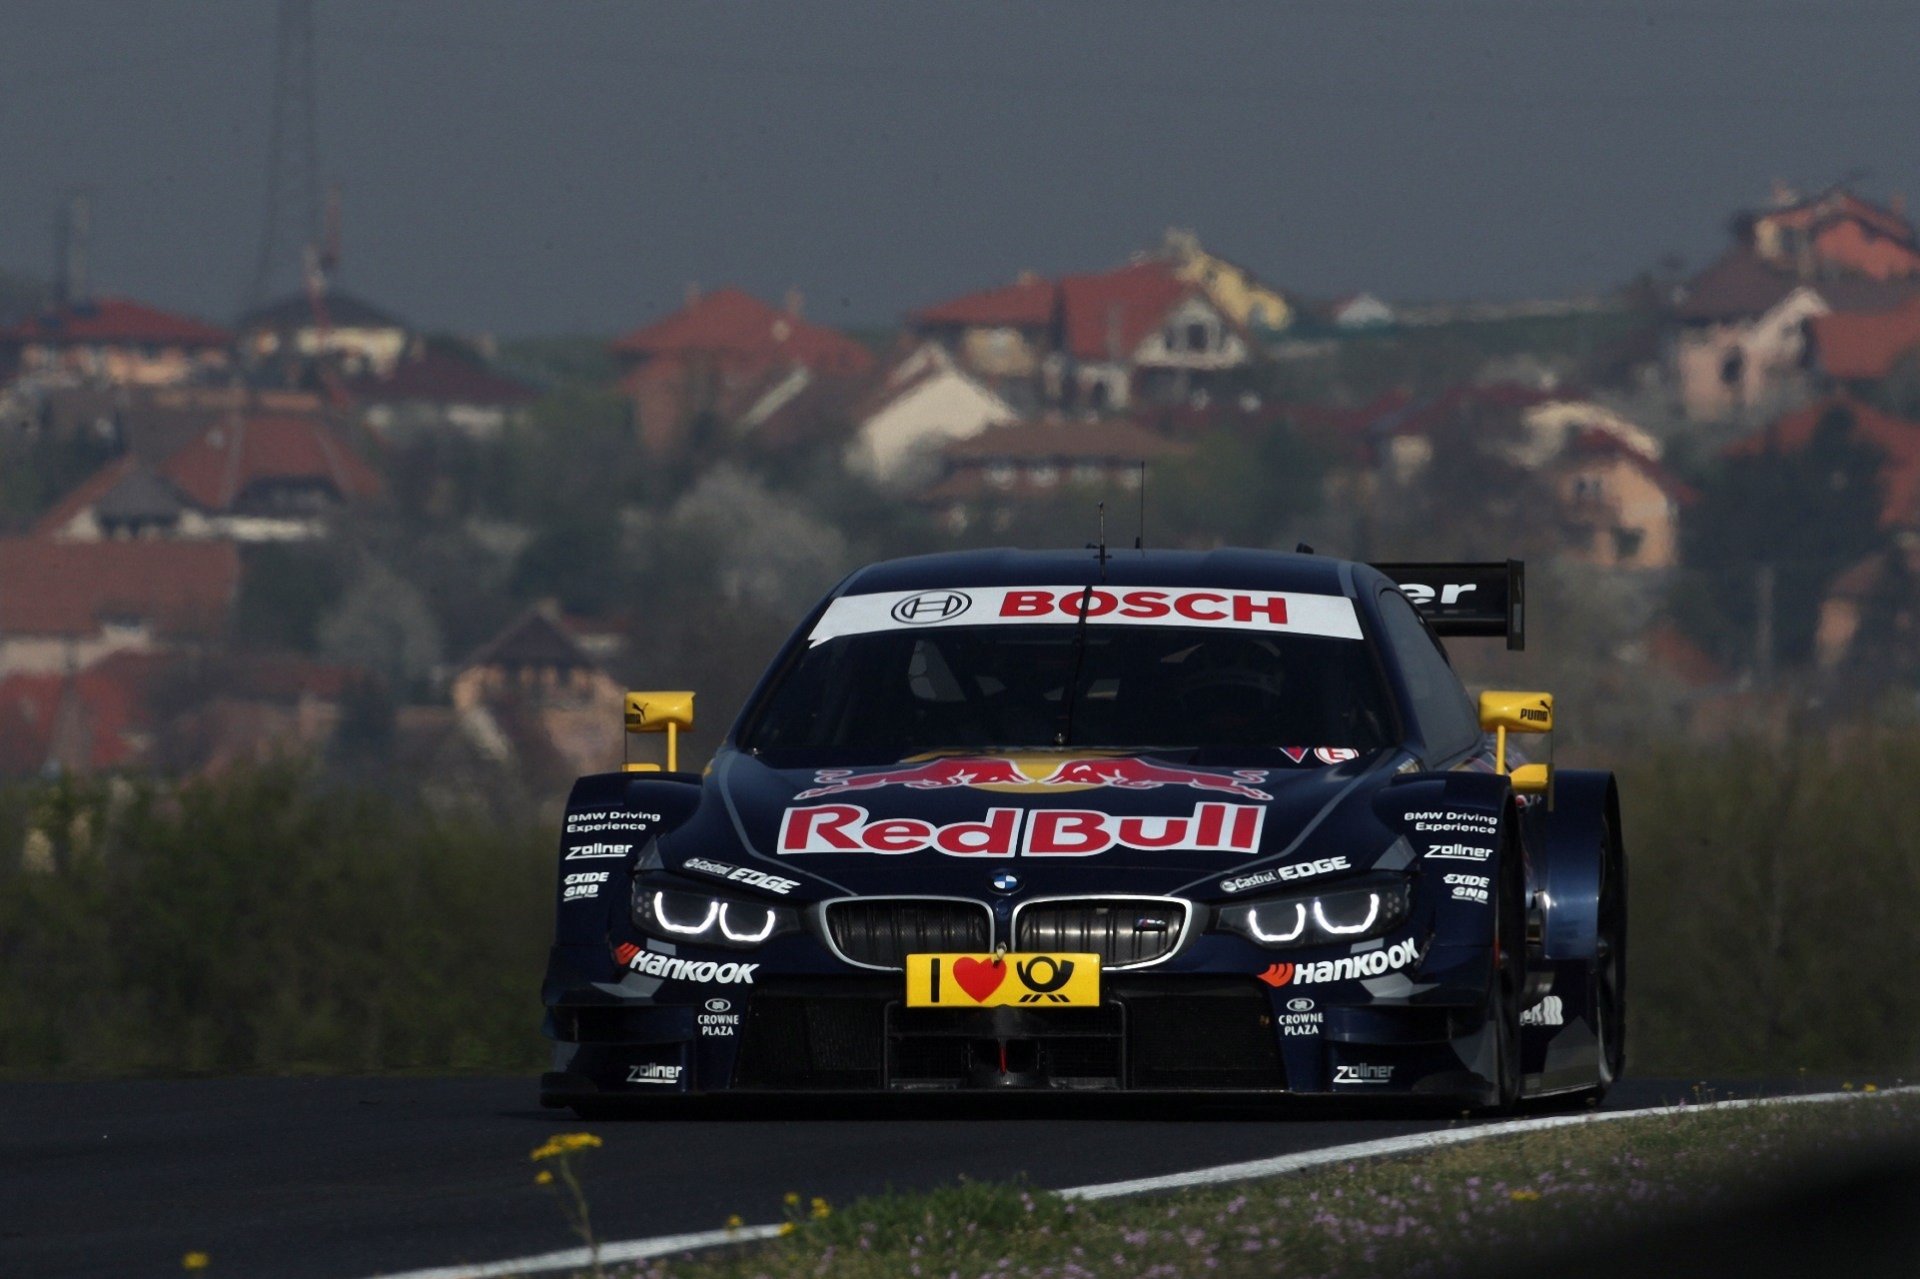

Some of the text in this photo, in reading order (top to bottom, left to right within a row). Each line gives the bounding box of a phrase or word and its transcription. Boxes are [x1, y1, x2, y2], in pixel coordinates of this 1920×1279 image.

[999, 591, 1288, 625] BOSCH
[1520, 708, 1548, 722] PUMA
[568, 811, 661, 823] BMW Driving
[1404, 812, 1498, 825] BMW Driving
[566, 822, 647, 833] Experience
[777, 802, 1267, 857] Red Bull
[1415, 822, 1497, 834] Experience
[564, 872, 610, 885] EXIDE
[1234, 856, 1351, 889] Castrol EDGE
[727, 868, 802, 894] EDGE
[1443, 874, 1490, 888] EXIDE
[931, 958, 941, 1002] I
[697, 1014, 739, 1025] CROWNE
[1278, 1012, 1324, 1025] CROWNE
[702, 1026, 734, 1036] PLAZA
[1284, 1024, 1319, 1036] PLAZA
